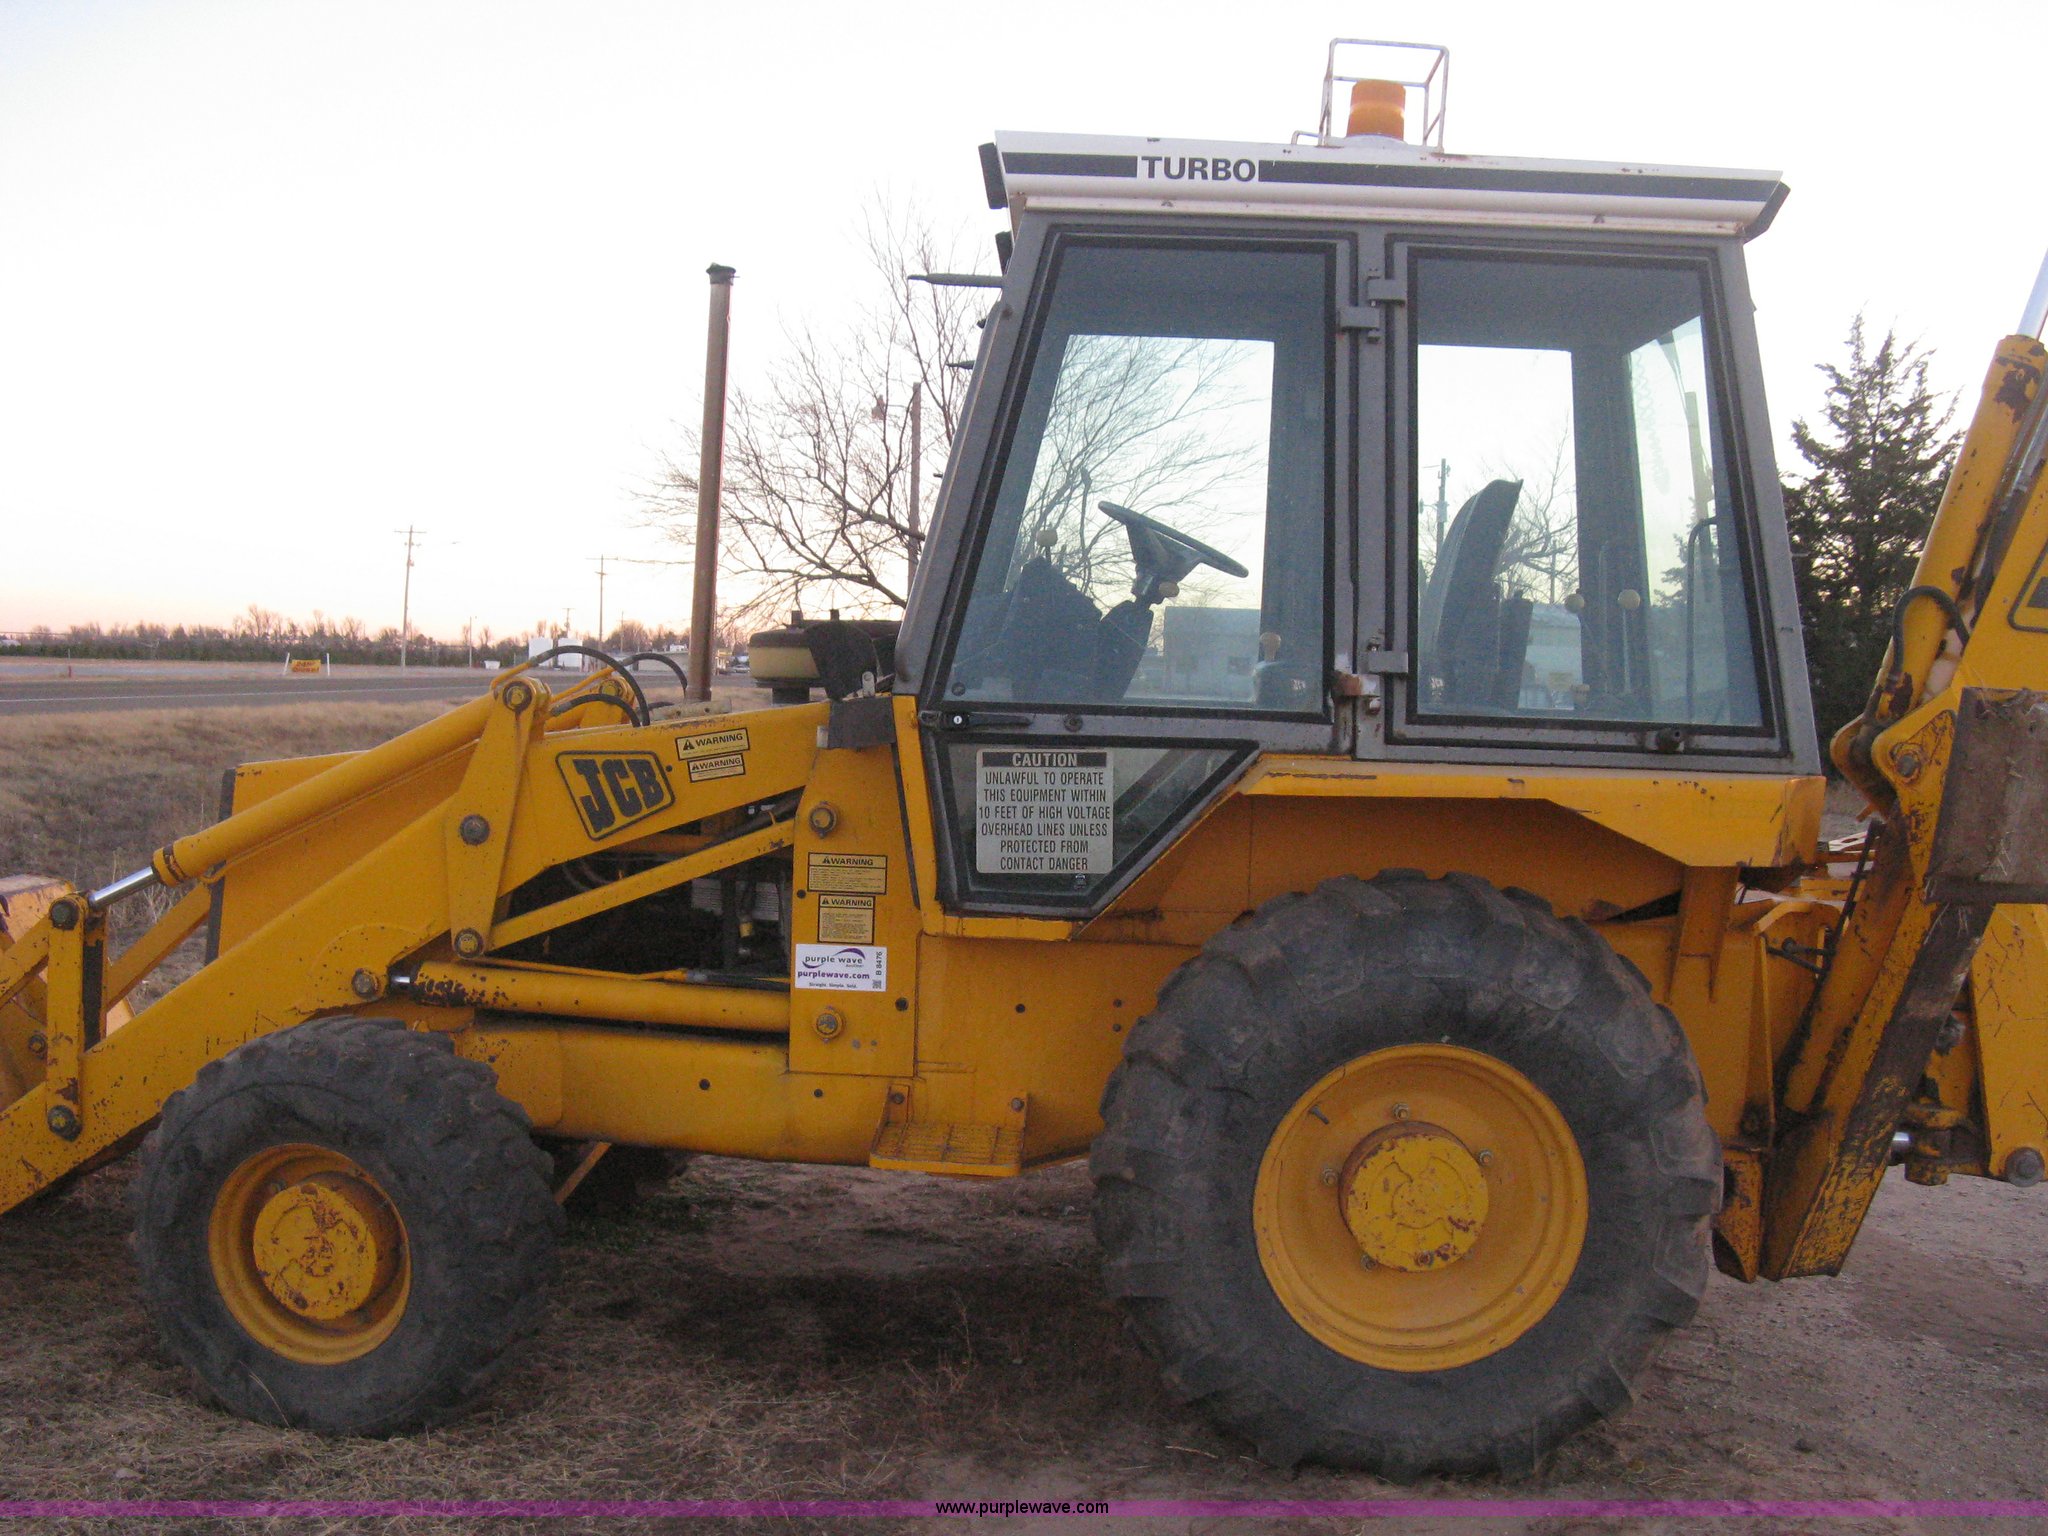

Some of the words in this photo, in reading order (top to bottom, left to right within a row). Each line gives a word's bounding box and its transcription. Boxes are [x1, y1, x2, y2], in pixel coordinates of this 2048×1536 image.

[1141, 156, 1256, 182] TURBO
[695, 733, 743, 746] WARNING
[699, 758, 740, 769] WARNING
[1012, 753, 1077, 767] CAUTION
[985, 772, 1039, 785] UNLAWFUL
[1044, 772, 1056, 785] TO
[1061, 772, 1104, 785] OPERATE
[572, 759, 664, 833] JCB
[984, 789, 1006, 802] THIS
[1010, 789, 1066, 802] EQUIPMENT
[1071, 789, 1106, 802] WITHIN
[979, 806, 990, 819] 10
[995, 806, 1017, 819] FEET
[1022, 806, 1034, 819] OF
[1039, 806, 1062, 819] HIGH
[1067, 806, 1110, 819] VOLTAGE
[981, 823, 1033, 836] OVERHEAD
[1038, 823, 1065, 836] LINES
[1070, 823, 1108, 836] UNLESS
[1000, 840, 1056, 853] PROTECTED
[1061, 841, 1089, 853] FROM
[831, 858, 873, 866] WARNING
[1000, 857, 1044, 870] CONTACT
[1049, 857, 1088, 870] DANGER
[831, 899, 872, 907] WARNING
[805, 955, 835, 963] purple
[797, 970, 870, 980] purplewave.com
